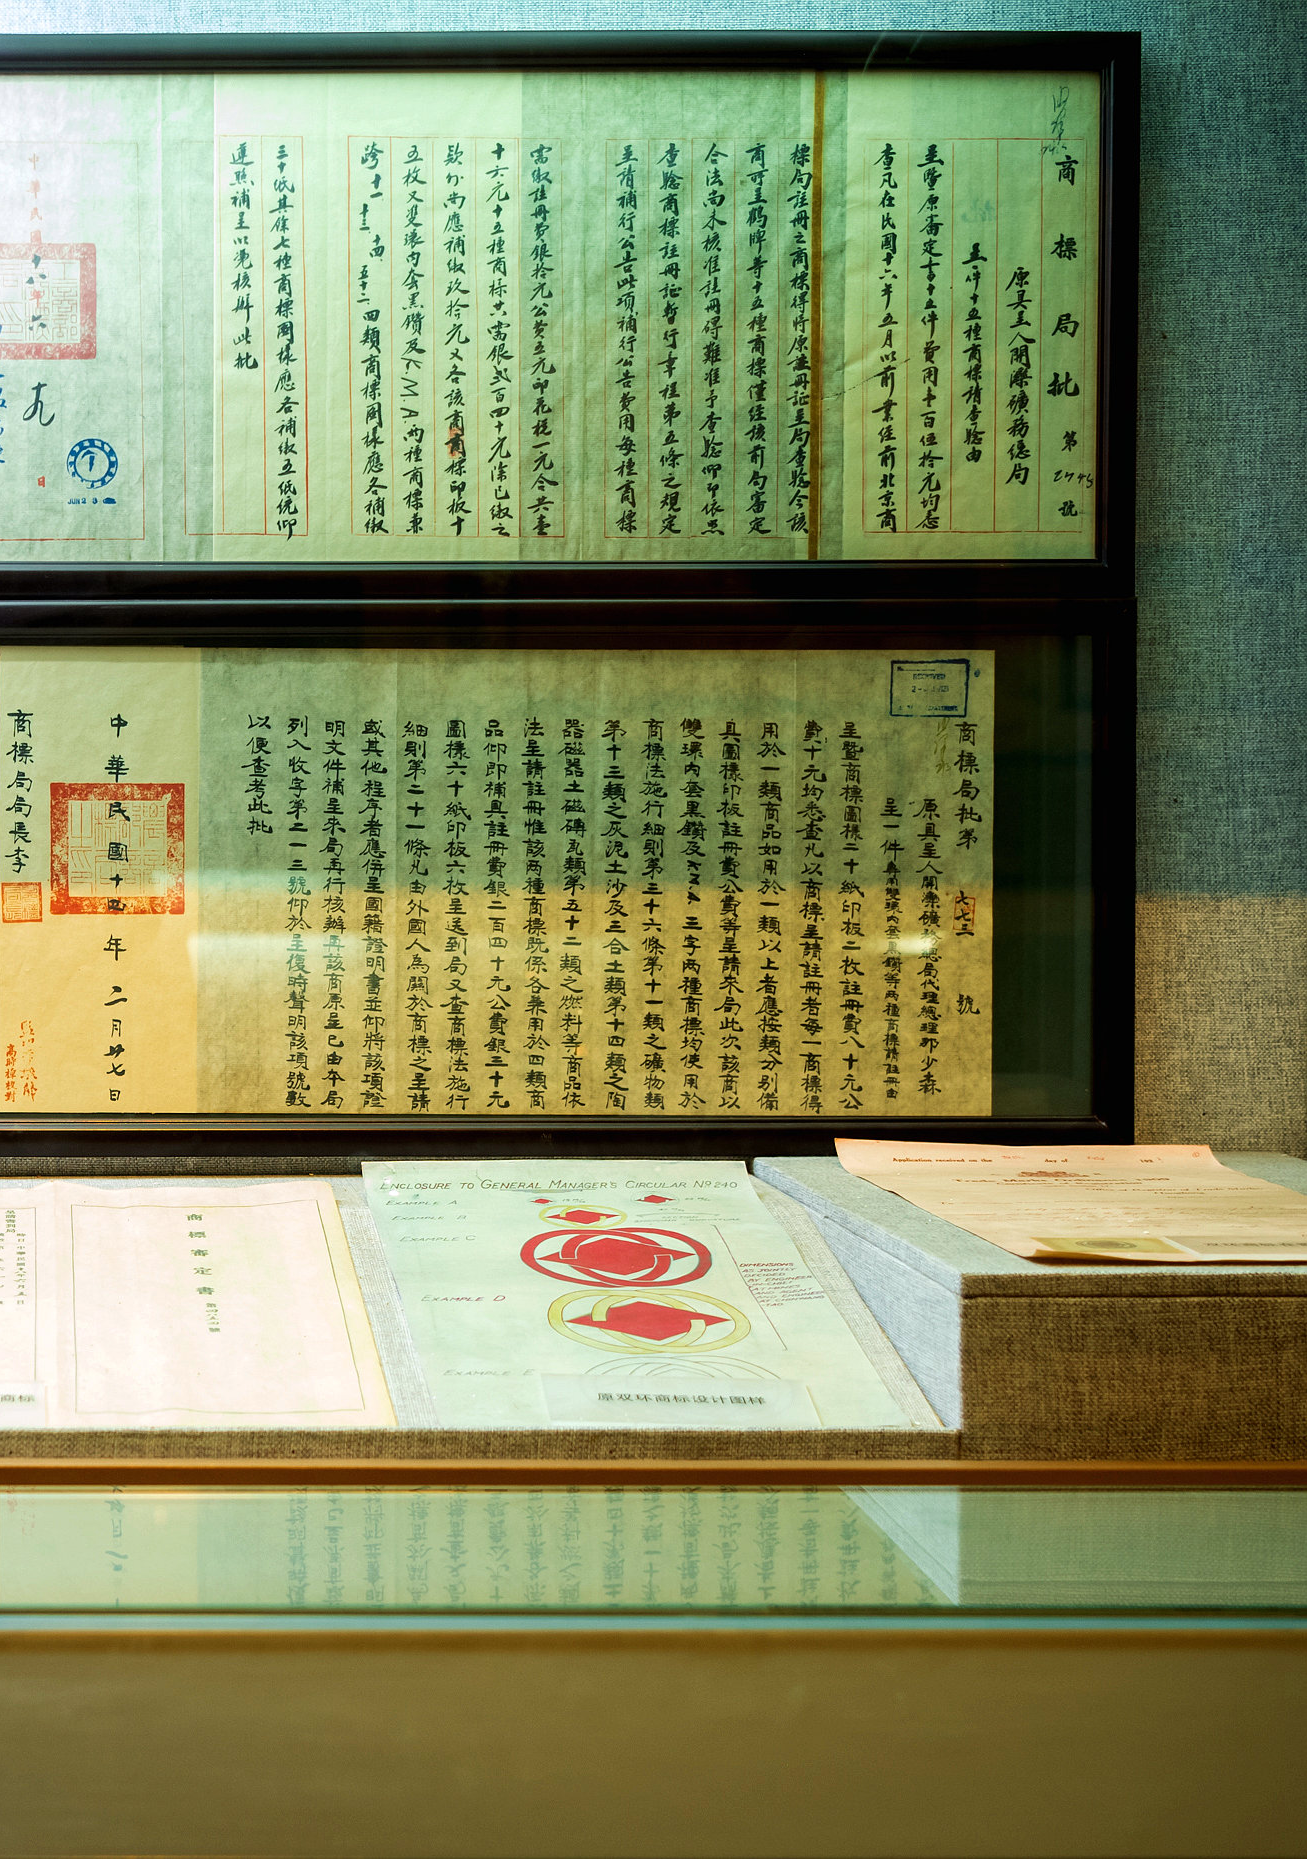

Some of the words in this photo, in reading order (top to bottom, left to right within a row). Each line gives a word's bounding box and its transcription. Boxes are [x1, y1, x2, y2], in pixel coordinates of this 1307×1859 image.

[241, 713, 273, 835] 以便查考此批
[480, 1179, 542, 1190] GENERAL
[624, 1180, 688, 1189] CIRCULAR
